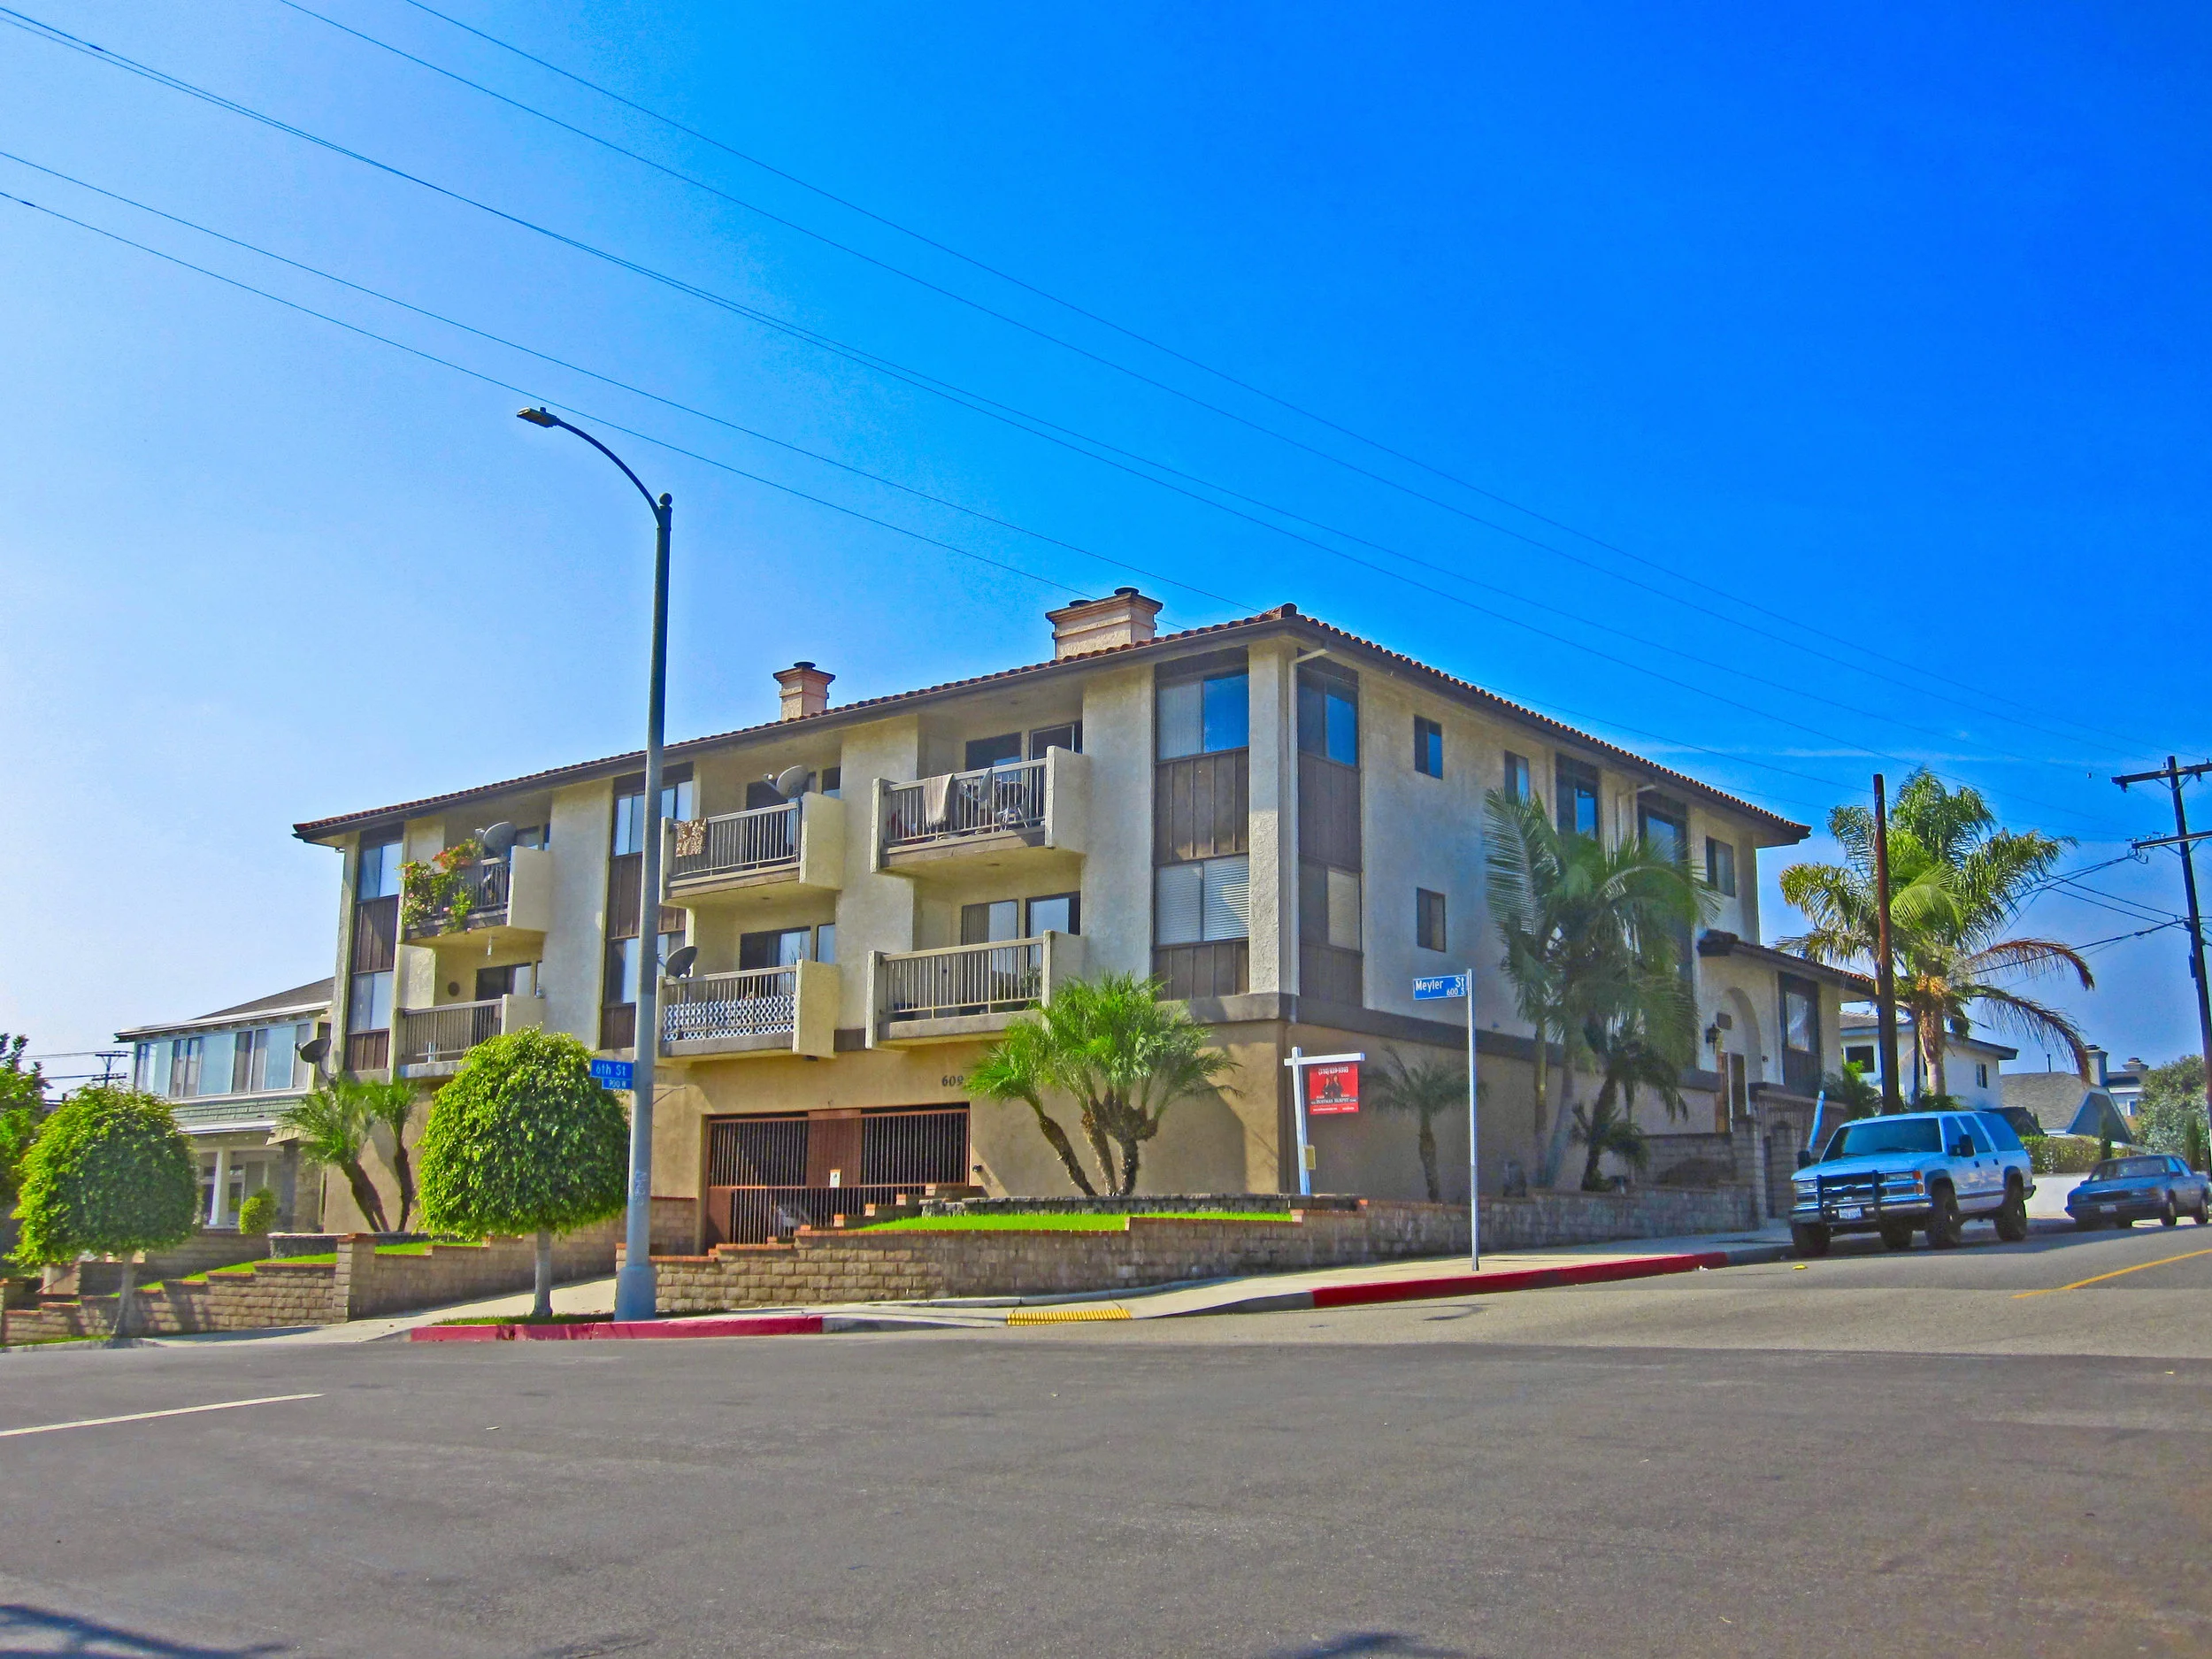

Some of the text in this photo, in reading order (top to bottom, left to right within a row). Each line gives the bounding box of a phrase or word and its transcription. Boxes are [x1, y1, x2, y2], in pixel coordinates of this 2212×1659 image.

[1415, 976, 1465, 993] Meyler St
[1446, 987, 1465, 996] 600 S
[595, 1062, 626, 1076] 6th St
